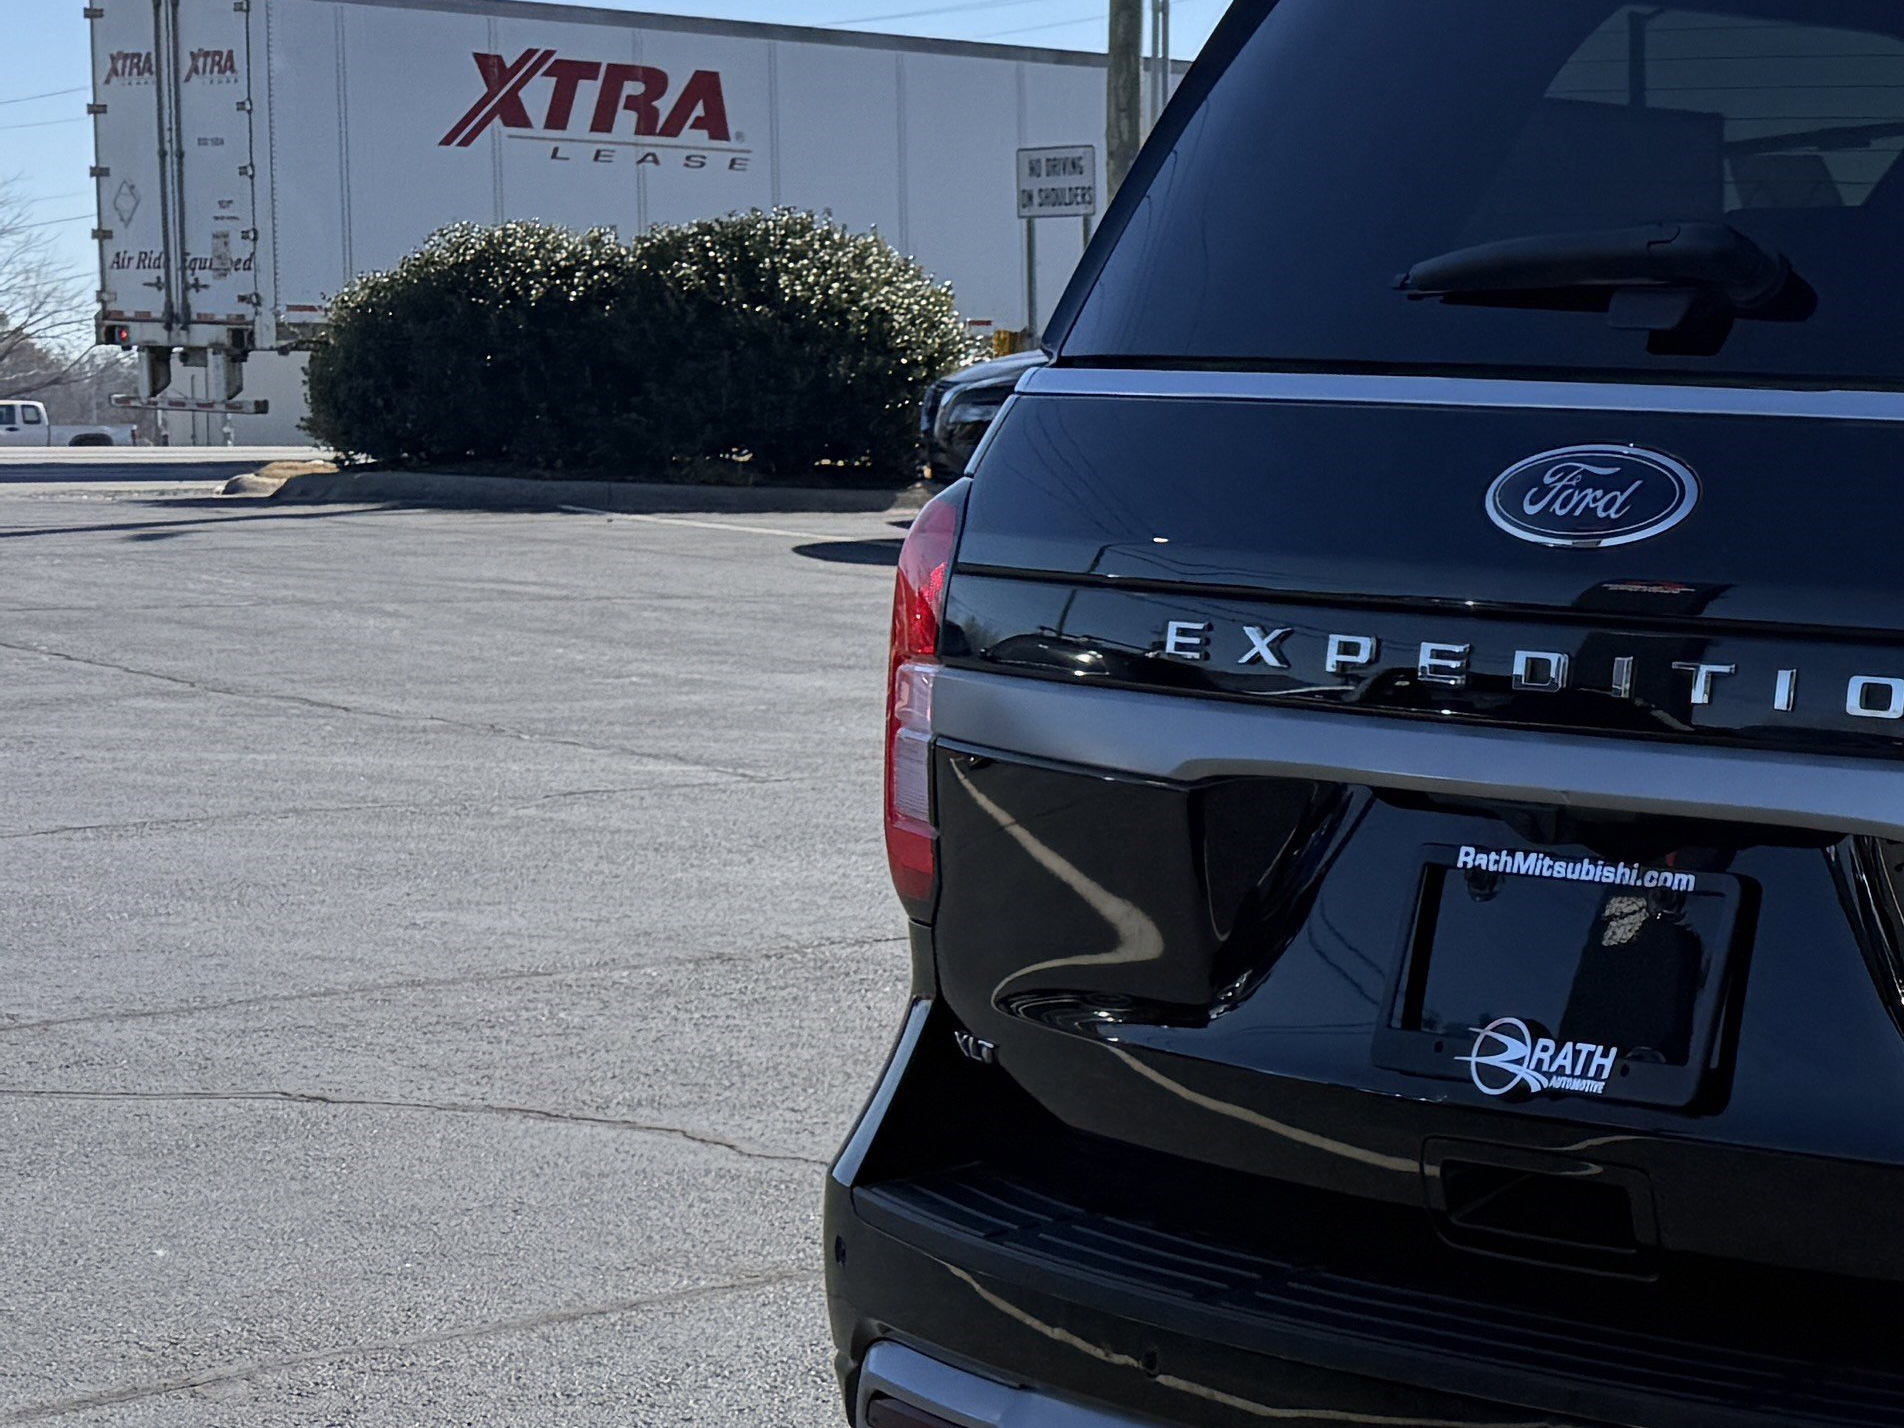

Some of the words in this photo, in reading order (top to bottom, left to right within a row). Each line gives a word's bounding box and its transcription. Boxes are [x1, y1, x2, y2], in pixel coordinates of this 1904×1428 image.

[104, 51, 153, 84] XTRA
[184, 48, 236, 83] XTRA
[438, 47, 731, 147] XTRA
[550, 146, 750, 172] LEASE
[1038, 186, 1092, 207] SHOULDERS
[111, 251, 133, 270] Air
[136, 250, 168, 270] Rid
[182, 252, 255, 276] Equied
[1523, 462, 1643, 519] Ford
[1456, 845, 1696, 892] RathMitsubishi.com
[954, 1031, 994, 1064] XLT
[1530, 1038, 1618, 1080] RATH
[1549, 1075, 1606, 1095] AUTOMOTIVE
